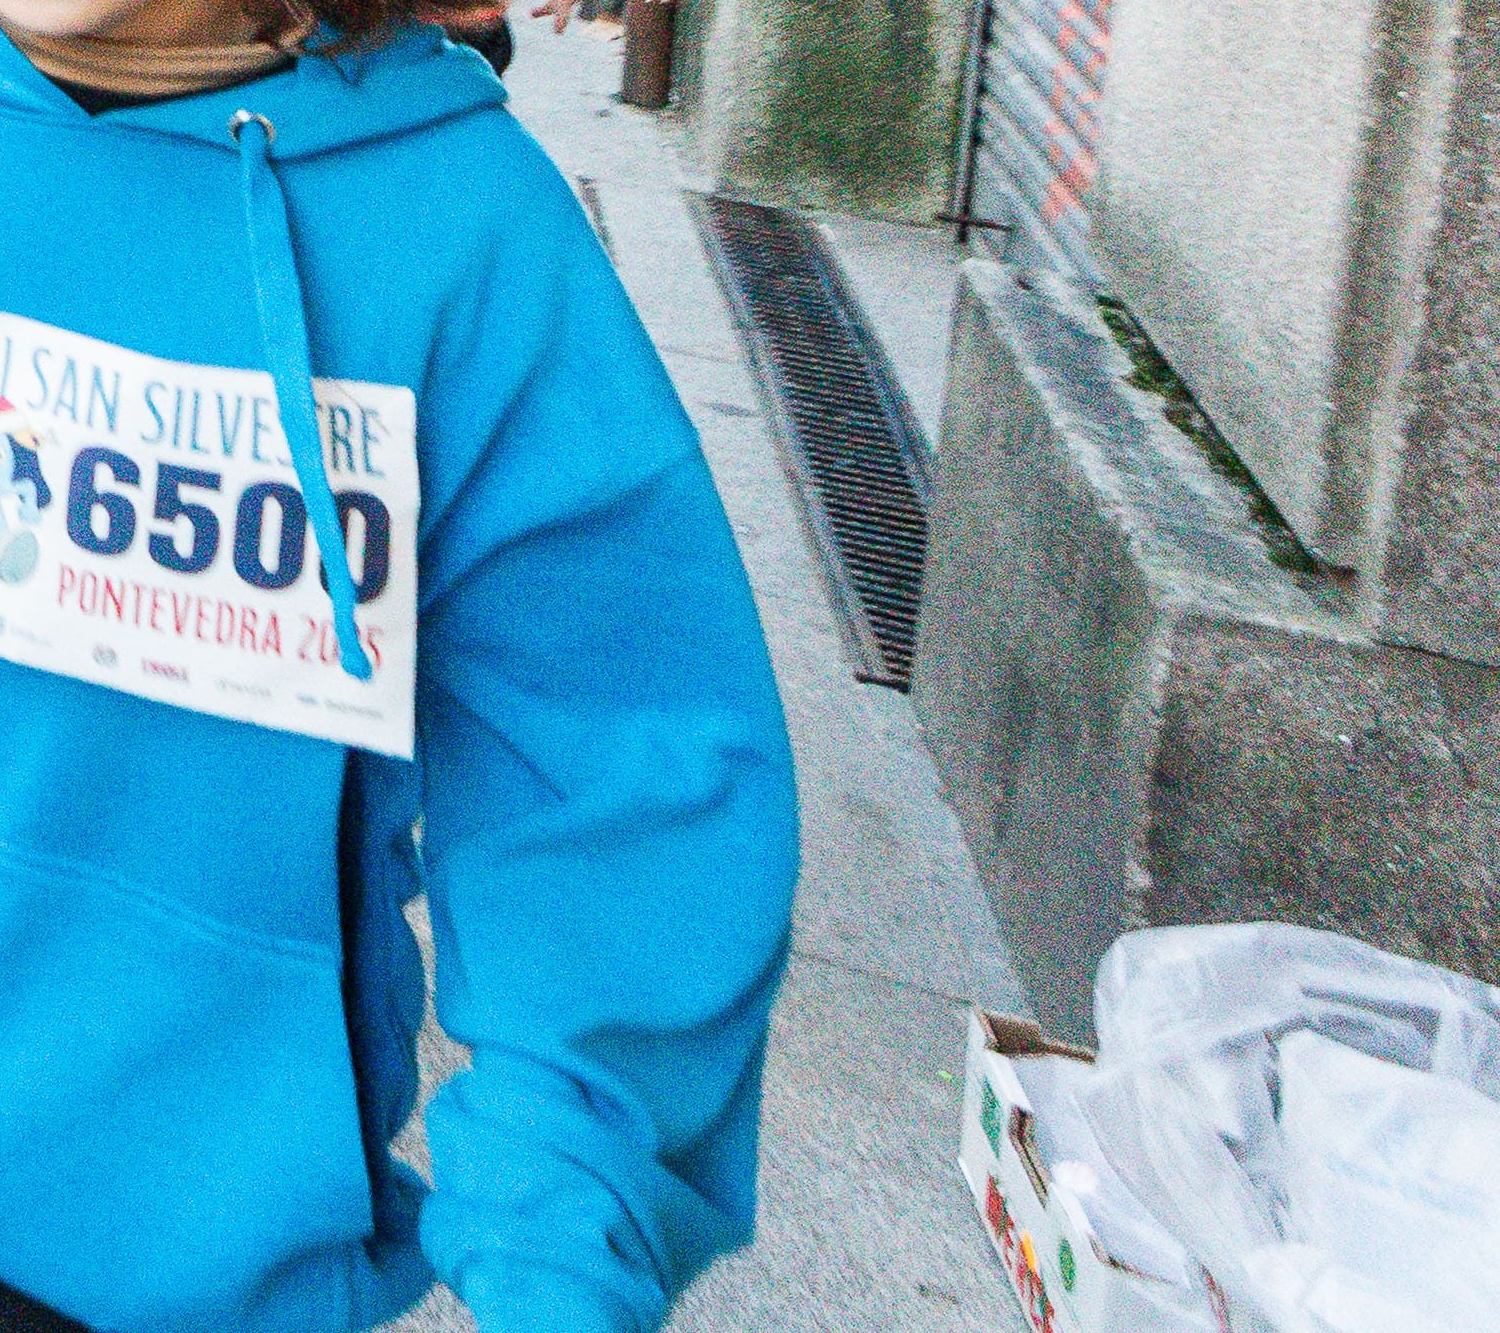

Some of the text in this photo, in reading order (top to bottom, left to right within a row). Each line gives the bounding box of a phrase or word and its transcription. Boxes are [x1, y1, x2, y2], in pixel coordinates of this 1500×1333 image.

[26, 349, 121, 436] SAN
[65, 442, 391, 606] 6500
[57, 564, 283, 659] PONTEVEDRA
